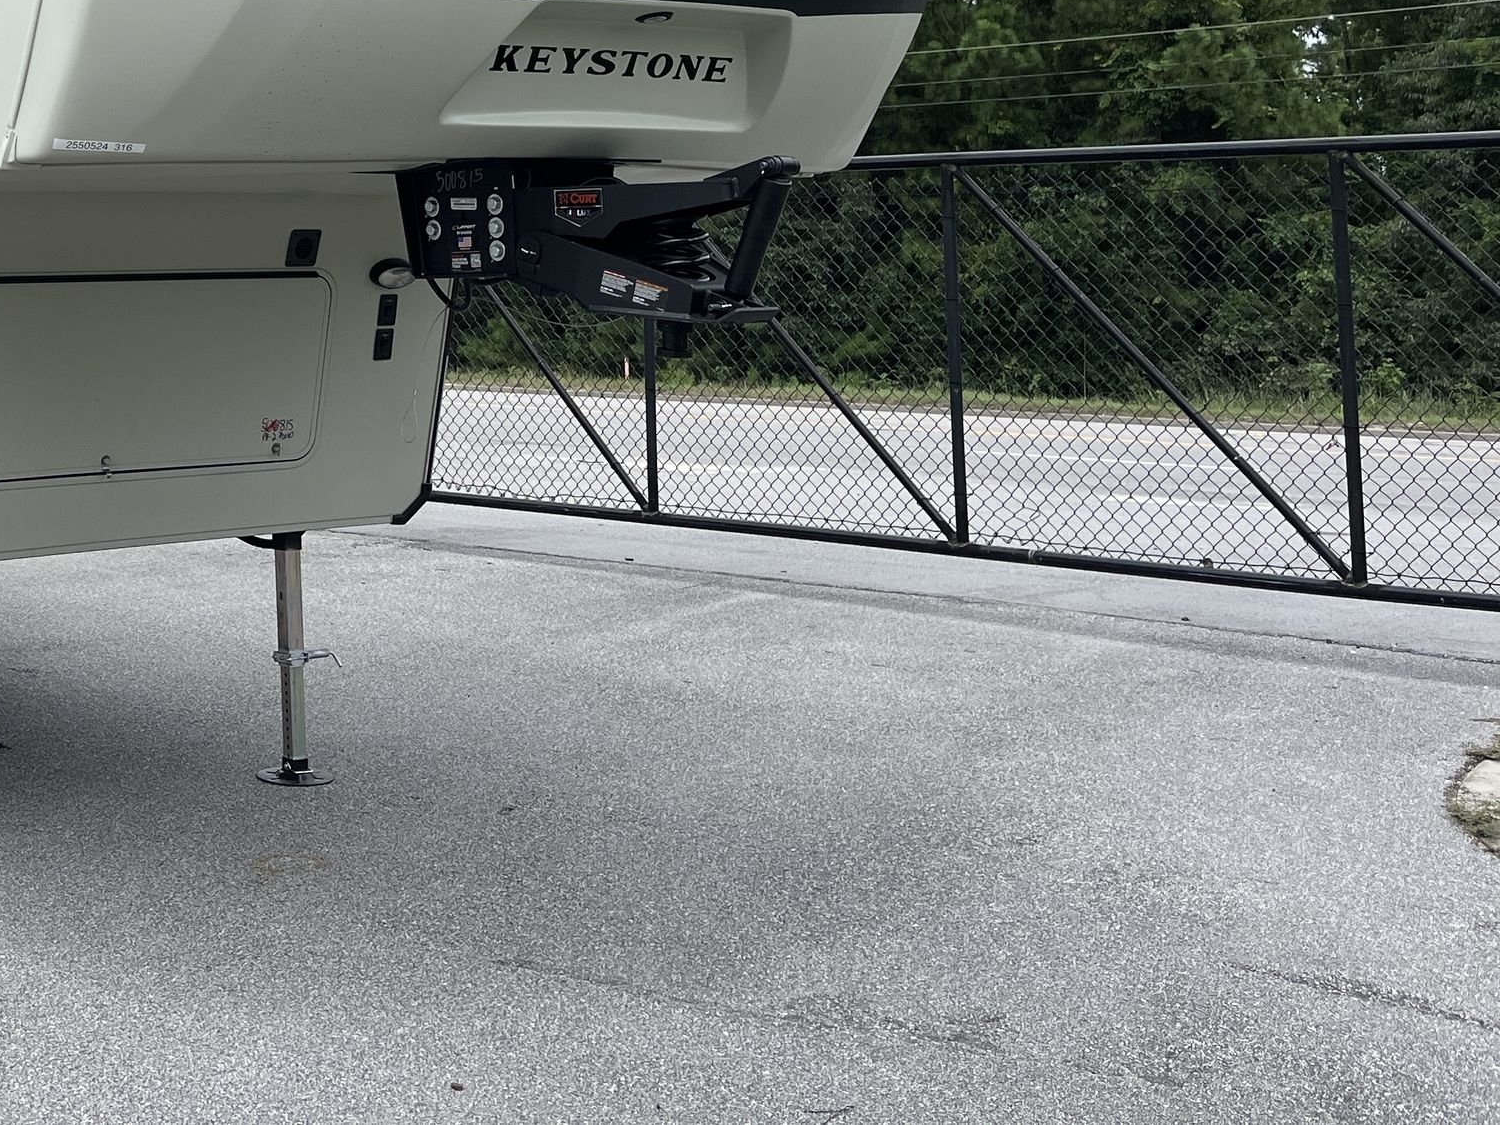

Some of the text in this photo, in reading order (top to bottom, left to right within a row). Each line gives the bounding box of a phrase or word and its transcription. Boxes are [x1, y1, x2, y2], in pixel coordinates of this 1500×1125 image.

[489, 44, 733, 83] KEYSTONE
[65, 140, 133, 152] 2550524 316
